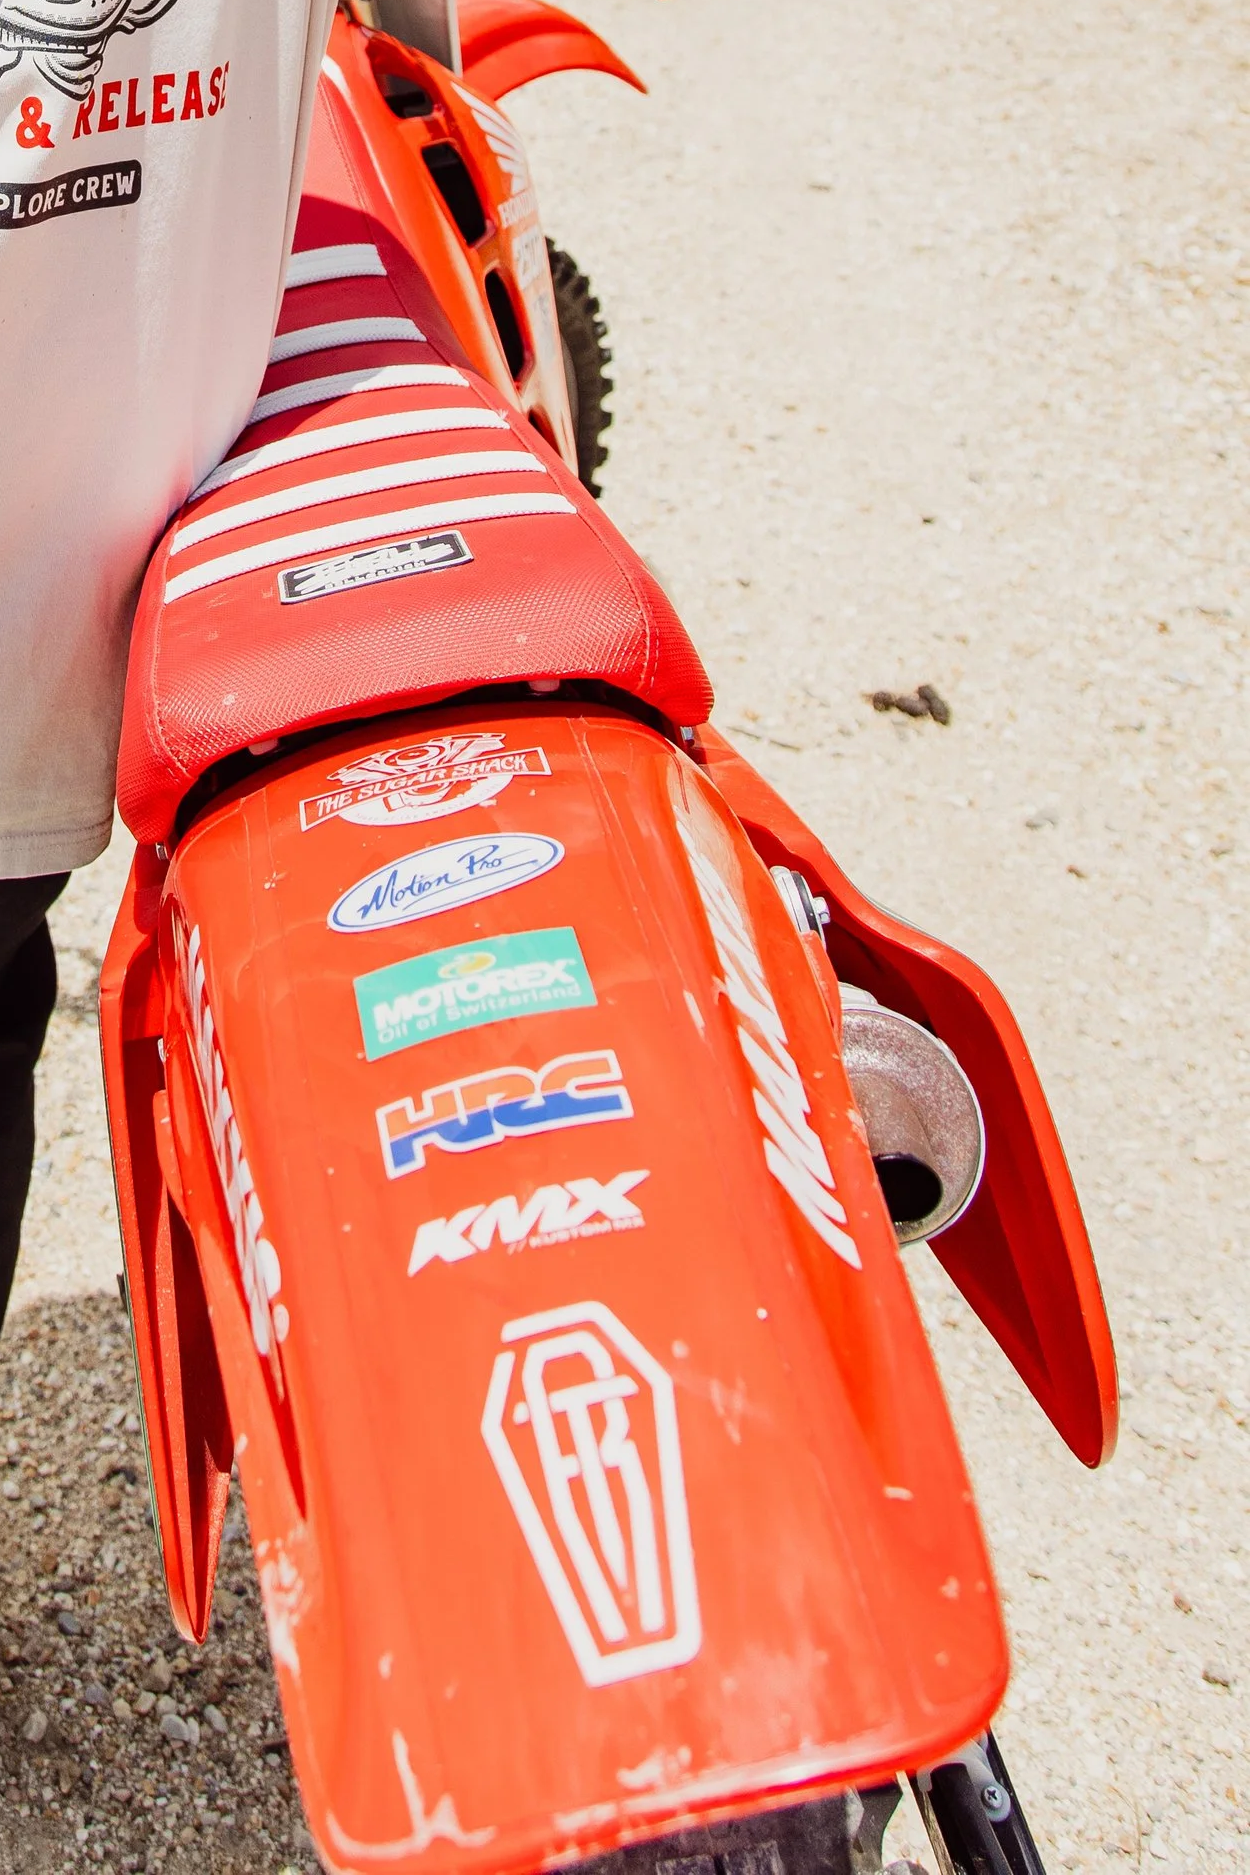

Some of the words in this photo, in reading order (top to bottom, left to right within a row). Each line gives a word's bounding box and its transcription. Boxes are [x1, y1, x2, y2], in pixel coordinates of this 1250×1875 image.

[16, 96, 55, 149] &
[72, 170, 136, 203] CREW
[316, 794, 352, 818] THE
[357, 768, 446, 802] SUGAR
[452, 754, 528, 777] SHACK
[357, 869, 461, 919] Motion
[458, 844, 526, 875] Pro
[373, 959, 576, 1029] MOTOREX
[378, 1023, 408, 1044] Oil
[416, 1014, 439, 1033] of
[446, 982, 582, 1022] Switzerland
[375, 1049, 634, 1181] HRC
[407, 1169, 650, 1277] KMX
